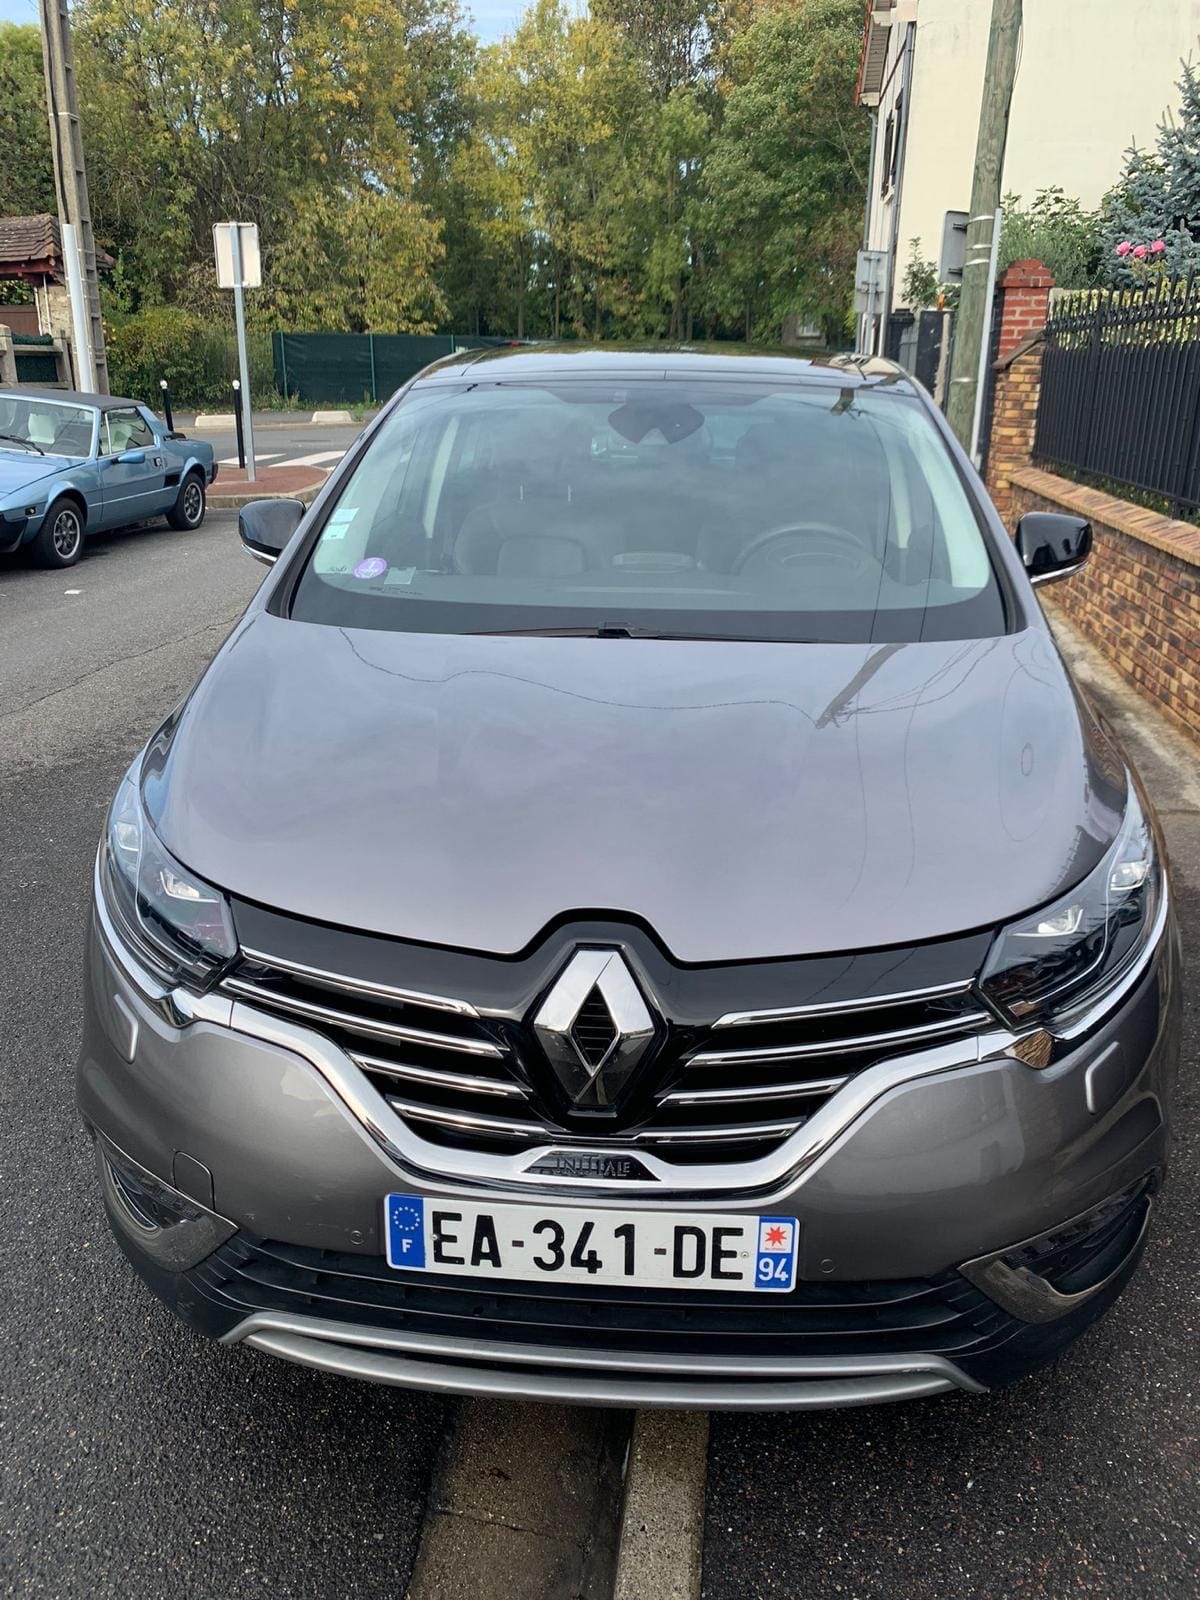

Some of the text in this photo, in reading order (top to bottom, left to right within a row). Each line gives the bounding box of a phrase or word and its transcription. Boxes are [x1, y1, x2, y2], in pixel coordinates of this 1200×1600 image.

[402, 1238, 413, 1253] F
[432, 1210, 744, 1280] EA-341-DE
[758, 1257, 789, 1281] 94
